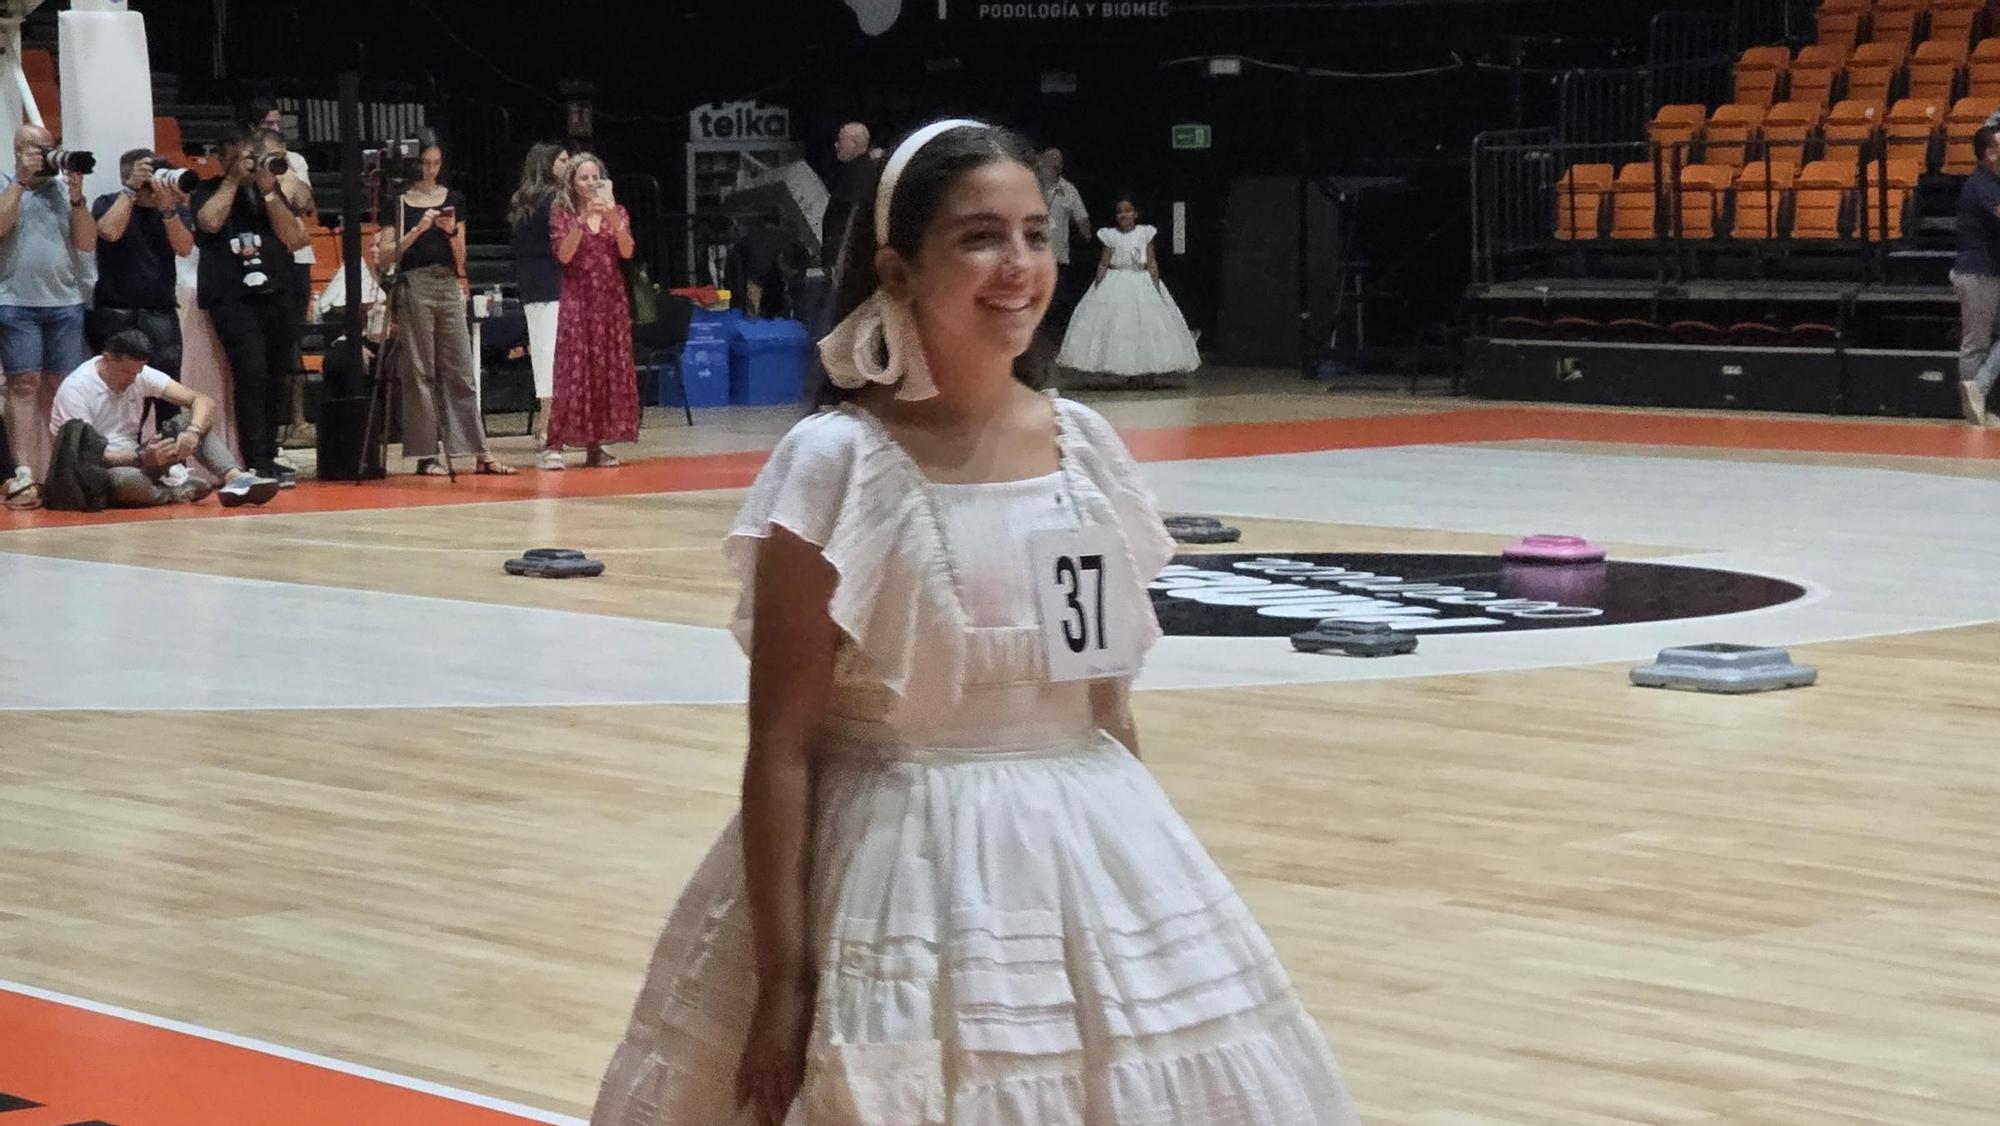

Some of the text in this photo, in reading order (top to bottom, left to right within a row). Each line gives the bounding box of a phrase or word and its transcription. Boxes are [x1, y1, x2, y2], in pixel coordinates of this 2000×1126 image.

[979, 1, 1080, 18] PODOLOGÍA
[1085, 3, 1096, 16] Y
[1056, 555, 1106, 652] 37
